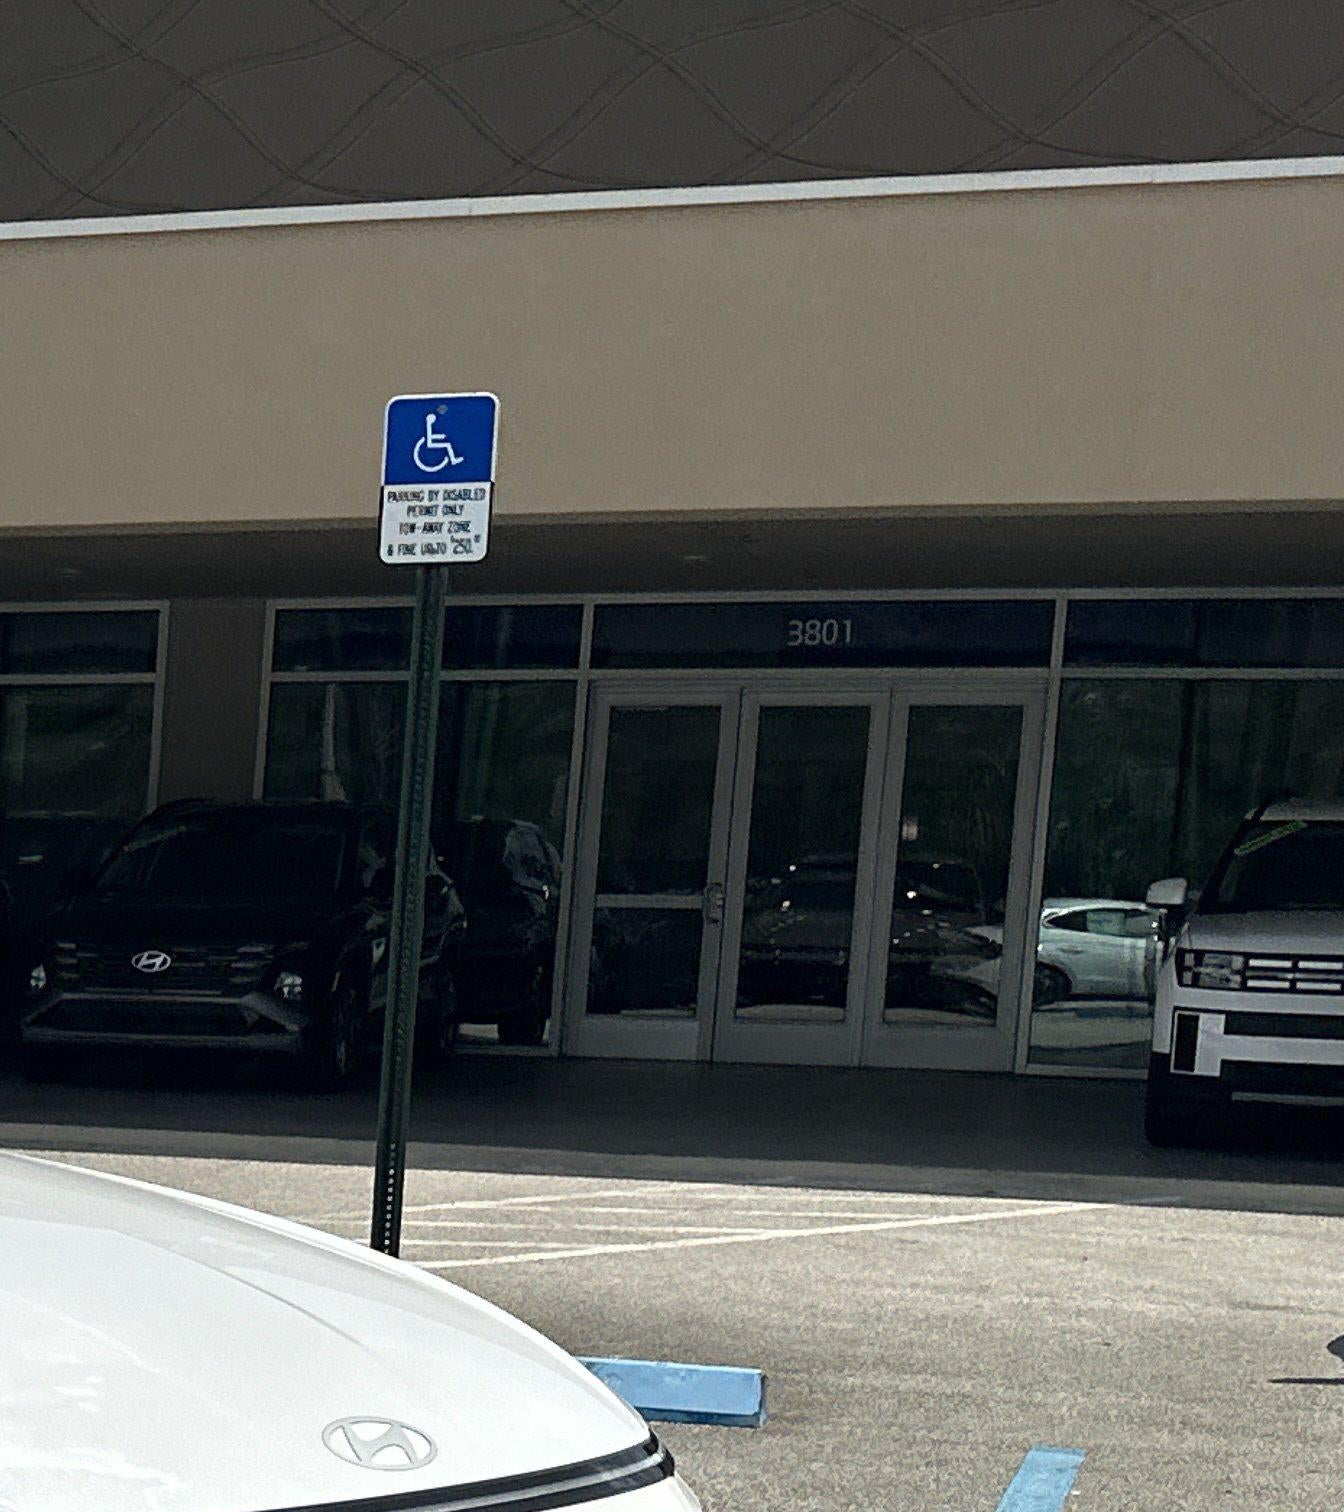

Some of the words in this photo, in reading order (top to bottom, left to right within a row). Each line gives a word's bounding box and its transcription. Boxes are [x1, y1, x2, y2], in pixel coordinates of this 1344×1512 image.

[427, 489, 439, 502] BY
[442, 504, 464, 516] ONLY
[786, 618, 852, 646] 3801
